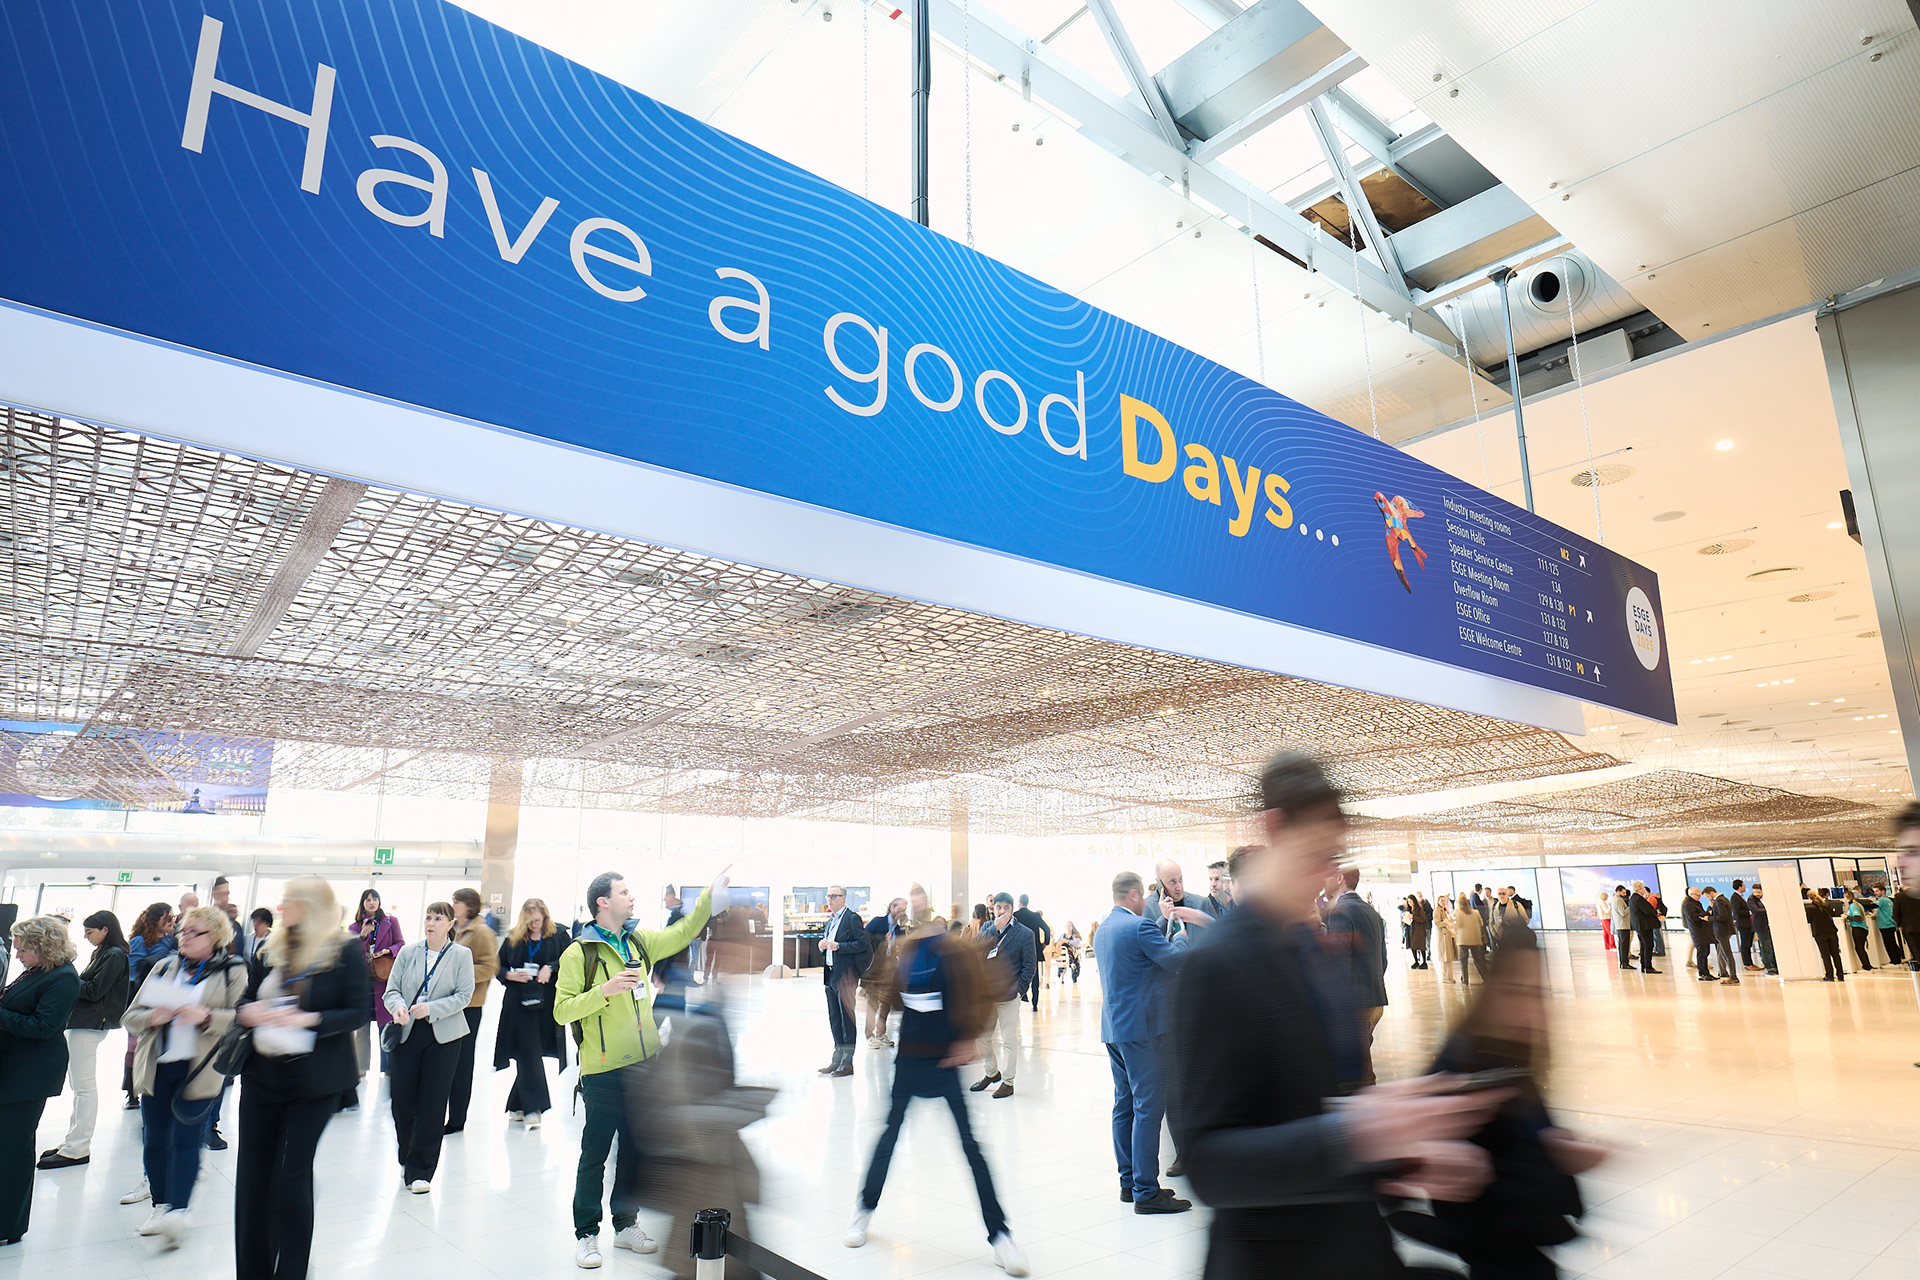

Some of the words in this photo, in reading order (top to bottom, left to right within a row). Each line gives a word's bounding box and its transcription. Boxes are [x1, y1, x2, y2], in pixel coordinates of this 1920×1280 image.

[180, 14, 654, 303] Have
[708, 267, 771, 352] a
[823, 312, 1089, 461] good
[1443, 495, 1468, 520] Industry
[1469, 509, 1493, 531] meeting
[1494, 520, 1512, 536] rooms
[1560, 547, 1570, 561] M2
[1446, 518, 1470, 539] Session
[1470, 529, 1486, 546] Halls
[1538, 557, 1560, 576] 111-125
[1448, 539, 1473, 559] Speaker
[1473, 549, 1495, 568] Service
[1495, 557, 1514, 576] Centre
[1551, 580, 1562, 594] 134
[1451, 559, 1468, 578] ESGE
[1468, 566, 1493, 590] Meeting
[1493, 575, 1510, 593] Room
[1538, 593, 1549, 607] 129
[1549, 596, 1554, 609] &
[1554, 598, 1565, 613] 130
[1568, 604, 1577, 617] P1
[1453, 580, 1480, 601] Overflow
[1481, 590, 1499, 608] Room
[1540, 611, 1551, 625] 131
[1551, 615, 1556, 628] &
[1556, 617, 1567, 631] 132
[1456, 601, 1473, 619] ESGE
[1473, 607, 1491, 625] Office
[1543, 630, 1553, 644] 127
[1554, 633, 1559, 646] &
[1559, 635, 1570, 650] 128
[1632, 604, 1650, 623] ESGE
[1634, 619, 1653, 637] DAYS
[1459, 625, 1476, 643] ESGE
[1475, 631, 1503, 651] Welcome
[1503, 639, 1523, 657] Centre
[1546, 653, 1557, 667] 131
[1557, 655, 1562, 669] &
[1562, 657, 1573, 672] 132
[1636, 634, 1654, 652] 2025
